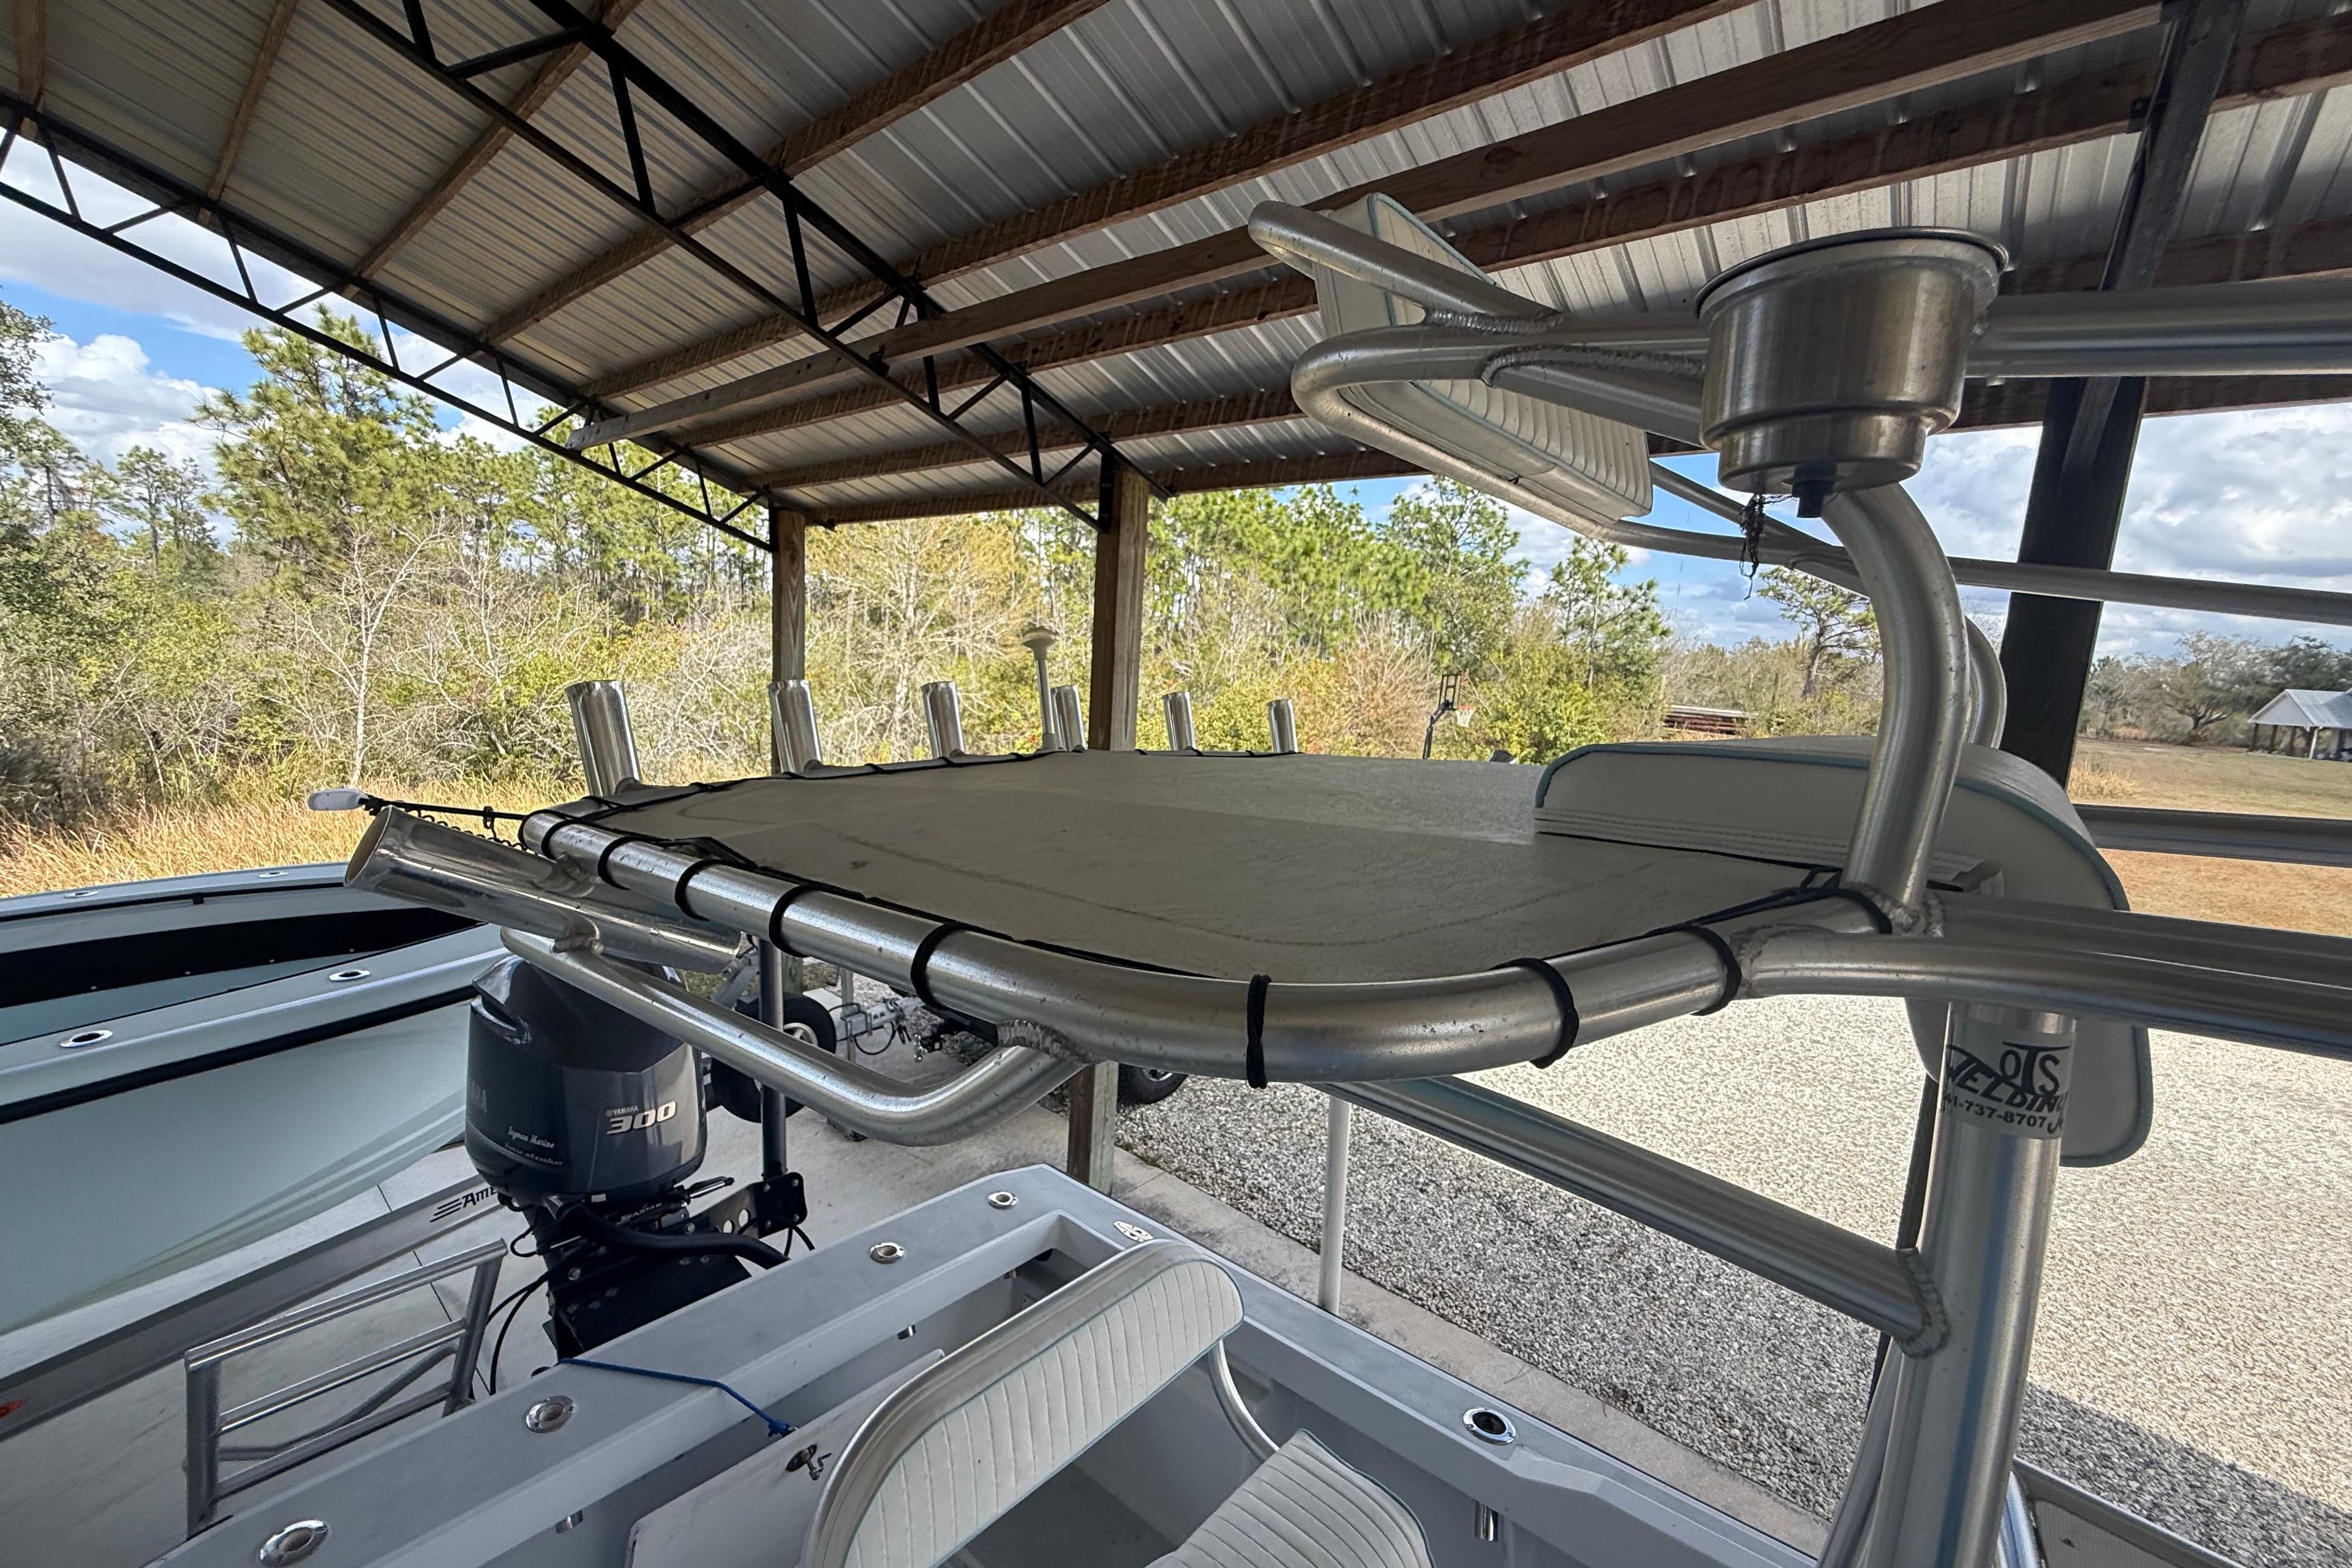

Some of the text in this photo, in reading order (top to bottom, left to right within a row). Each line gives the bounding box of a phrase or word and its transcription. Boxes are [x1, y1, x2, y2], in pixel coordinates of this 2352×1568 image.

[613, 1105, 639, 1116] YAMAHA
[606, 1101, 677, 1135] 300
[529, 1134, 556, 1148] Marine
